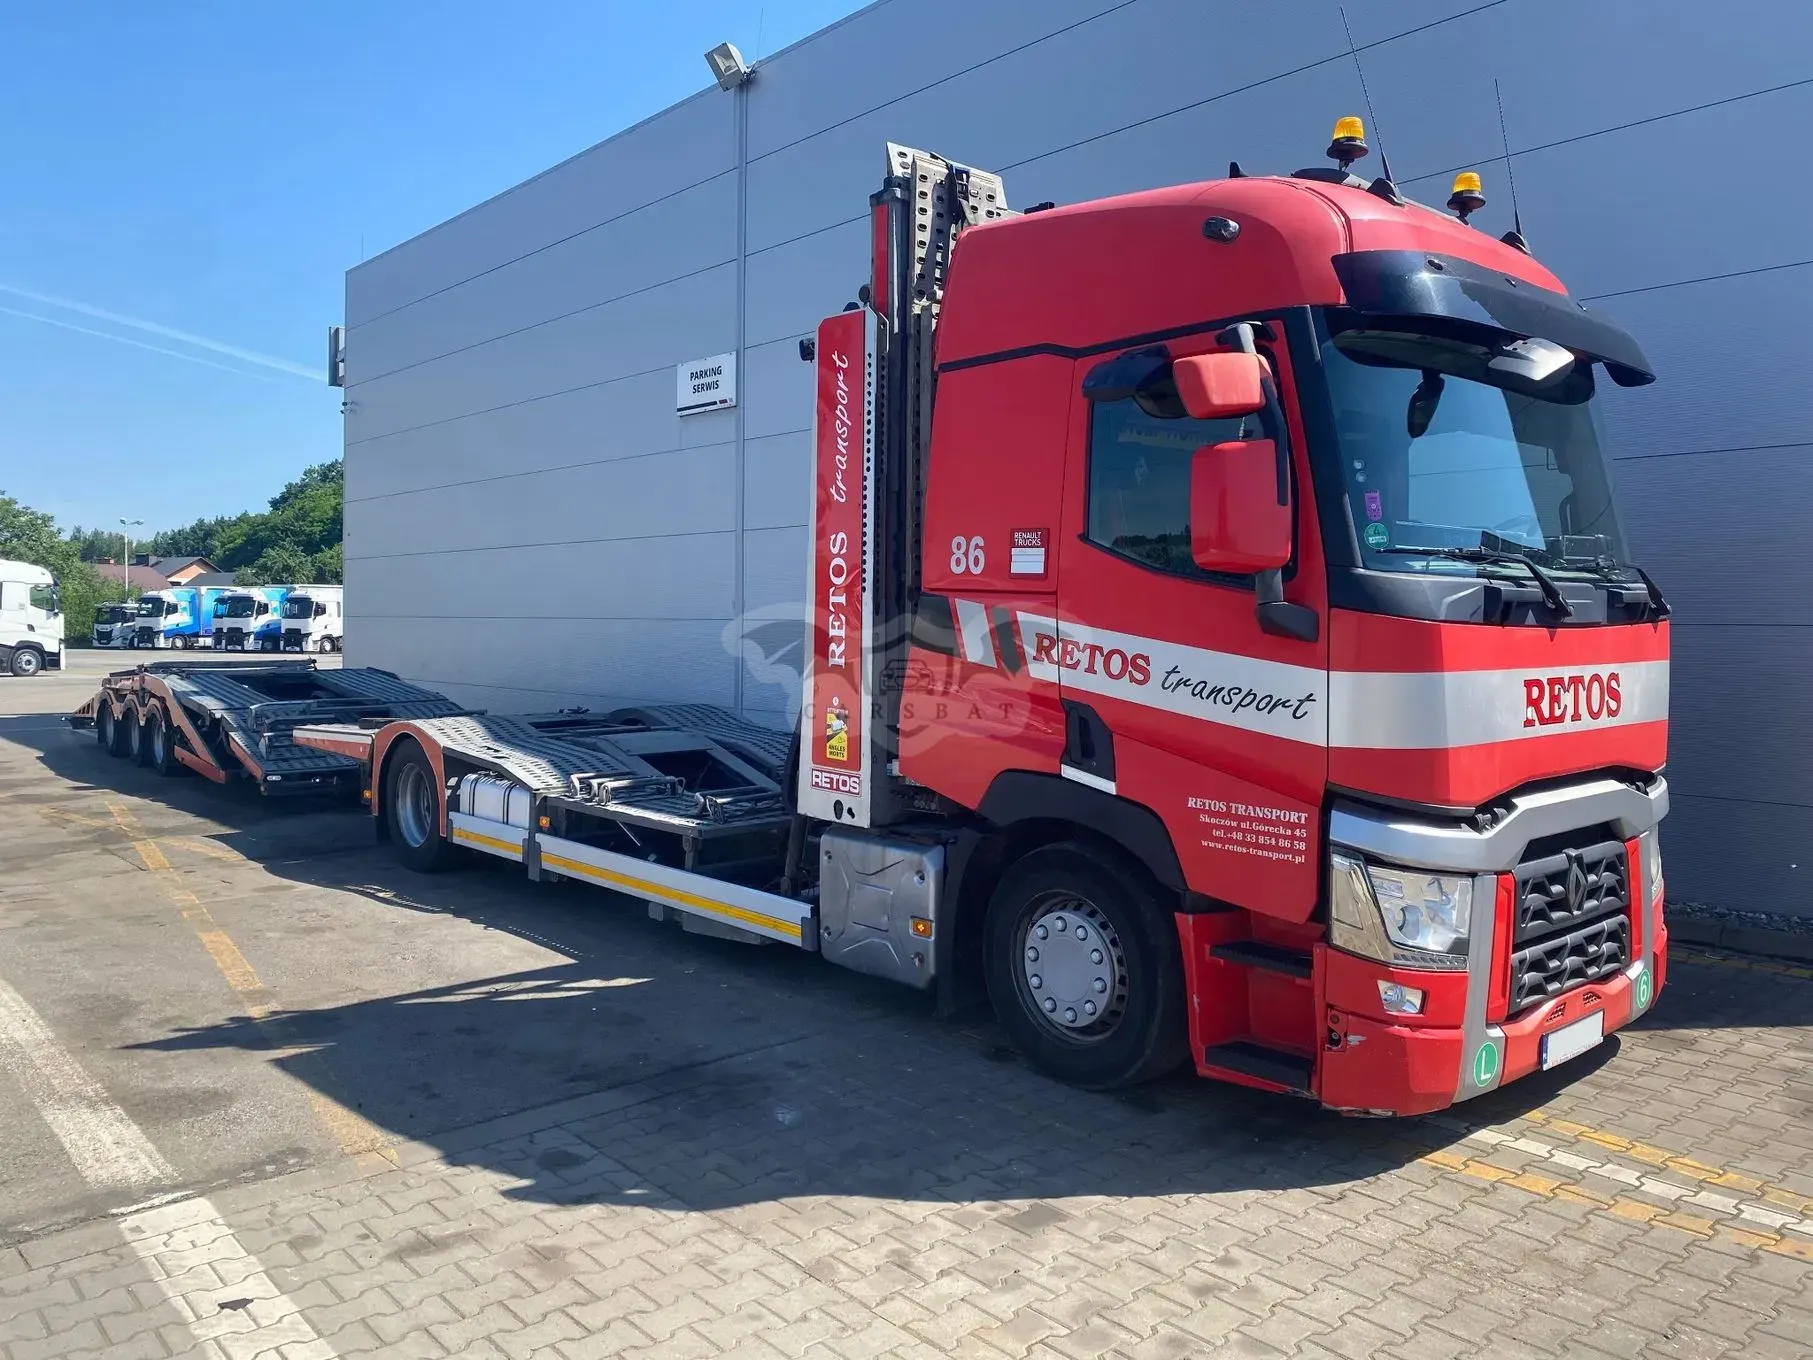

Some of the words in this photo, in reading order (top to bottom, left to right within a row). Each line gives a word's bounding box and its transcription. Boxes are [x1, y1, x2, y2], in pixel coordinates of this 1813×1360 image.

[690, 365, 722, 381] PARKING
[692, 380, 719, 394] SERWIS
[830, 350, 851, 503] transport
[1014, 531, 1042, 539] RENAULT
[1014, 538, 1041, 546] TRUCKS
[950, 535, 985, 575] 86
[828, 531, 848, 669] RETOS
[1032, 632, 1151, 686] RETOS
[1160, 665, 1317, 720] transport
[1523, 672, 1622, 728] RETOS
[829, 744, 846, 752] ANGLES
[829, 750, 845, 758] MORTS
[812, 769, 860, 794] RETOS
[1187, 797, 1227, 812] RETOS
[1229, 802, 1308, 824] TRANSPORT
[1199, 814, 1239, 828] Skoczów
[1293, 828, 1307, 838] 45
[1201, 839, 1305, 864] www.retos-transport.pl
[1245, 833, 1257, 843] 33
[1258, 835, 1277, 846] 854
[1278, 838, 1291, 849] 86
[1293, 841, 1306, 851] 58
[1640, 979, 1648, 1002] 6
[1481, 1052, 1492, 1081] L
